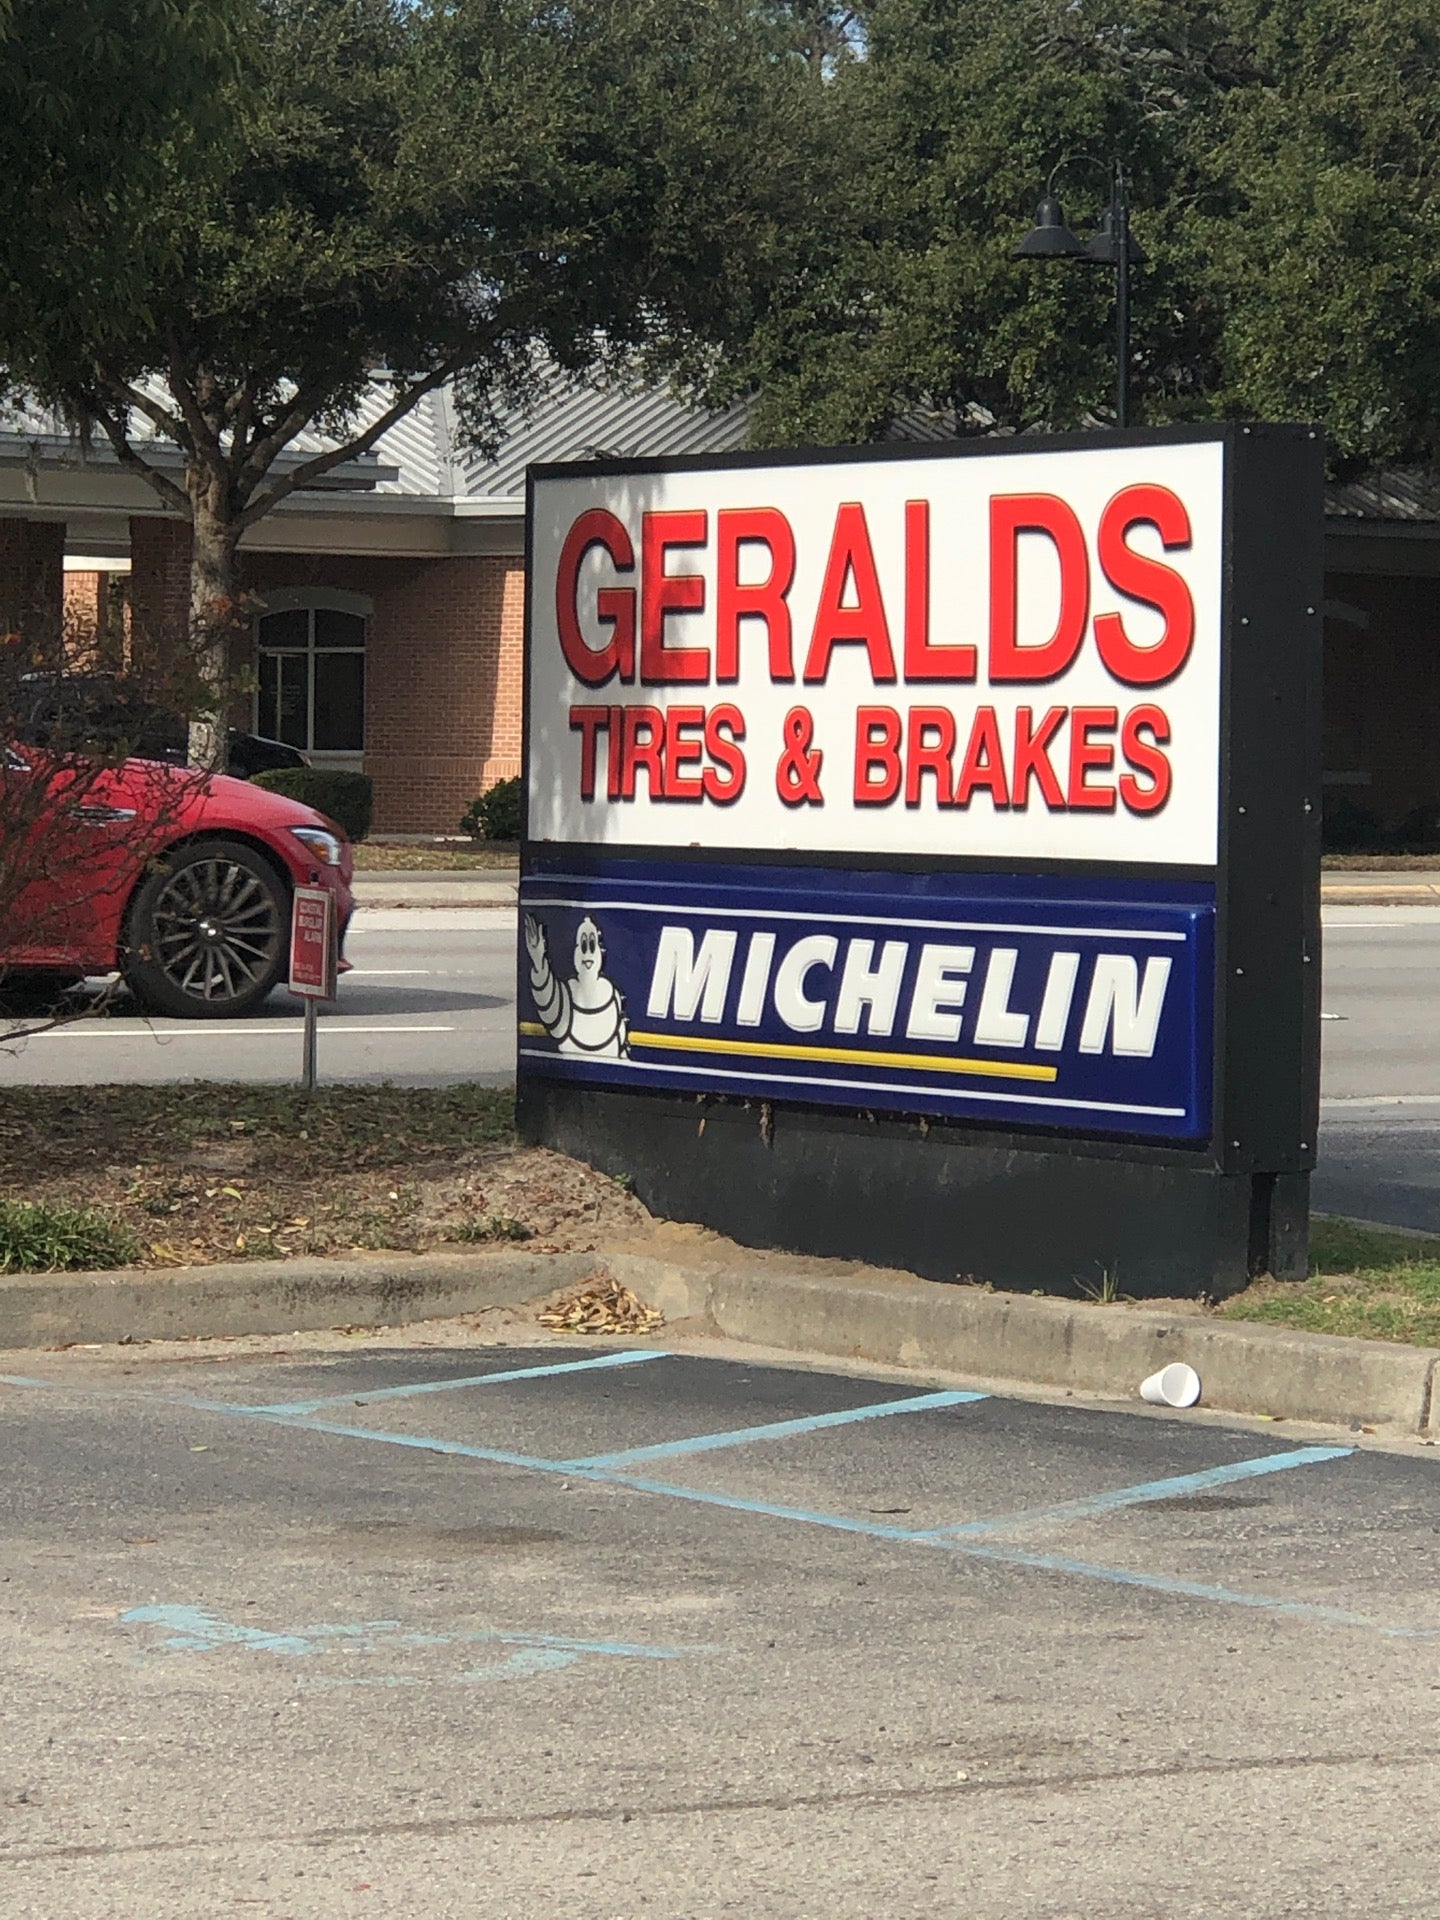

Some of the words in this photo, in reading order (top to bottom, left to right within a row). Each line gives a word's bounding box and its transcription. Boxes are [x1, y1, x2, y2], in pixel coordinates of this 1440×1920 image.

[556, 483, 1195, 687] GERALDS
[569, 703, 747, 803] TIRES
[775, 706, 824, 804] &
[853, 703, 1173, 815] BRAKES
[646, 926, 1173, 1058] MICHELIN
